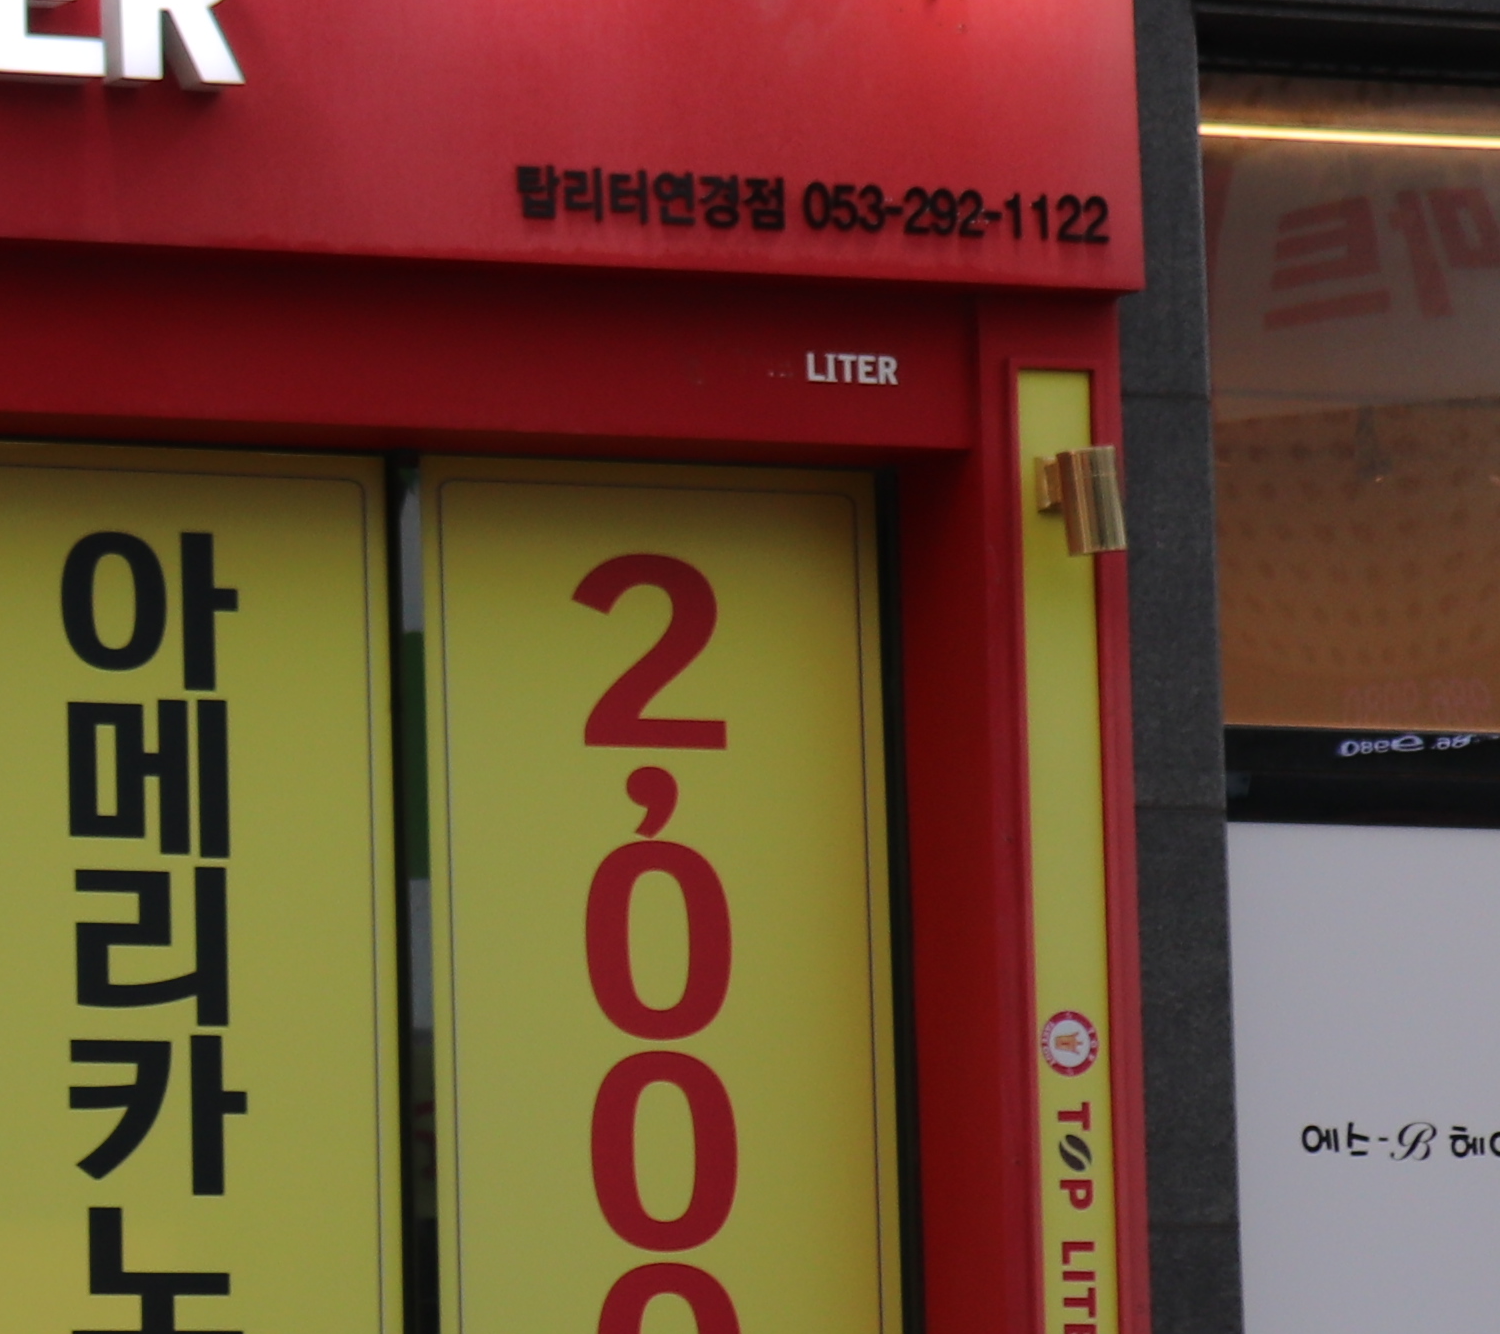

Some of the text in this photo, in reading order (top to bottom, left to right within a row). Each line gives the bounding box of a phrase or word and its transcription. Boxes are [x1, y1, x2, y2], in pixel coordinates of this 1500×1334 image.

[515, 163, 1111, 245] 탑리터연경점 053-292-1122
[806, 352, 899, 385] LITER
